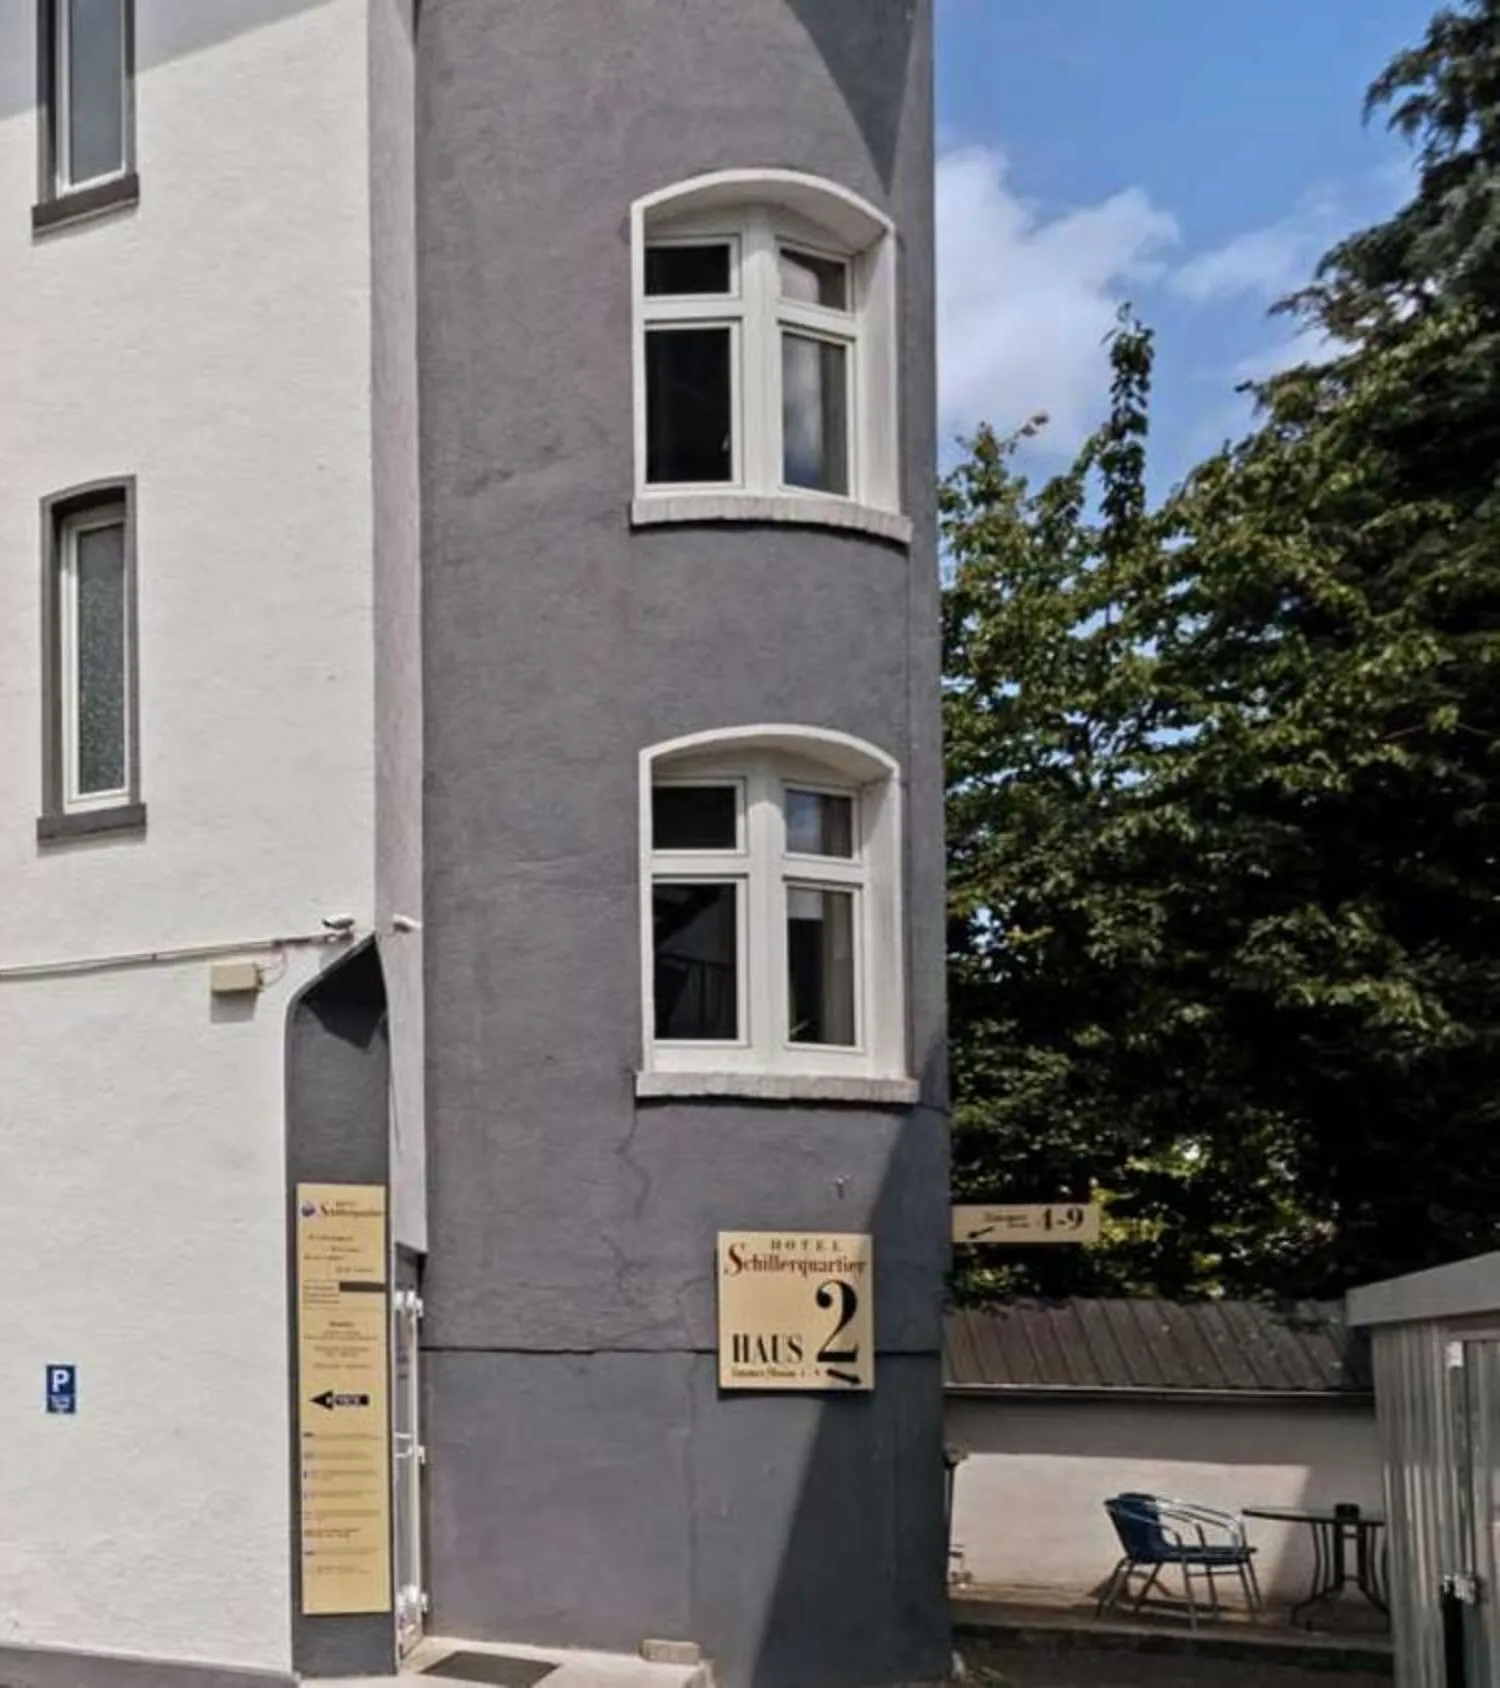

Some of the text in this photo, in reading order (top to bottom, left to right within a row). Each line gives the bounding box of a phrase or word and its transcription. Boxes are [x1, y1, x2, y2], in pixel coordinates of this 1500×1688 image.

[771, 1240, 842, 1250] HOTEL
[724, 1242, 866, 1278] Schillerquartier
[732, 1280, 858, 1363] HAUS 2
[53, 1370, 69, 1392] P
